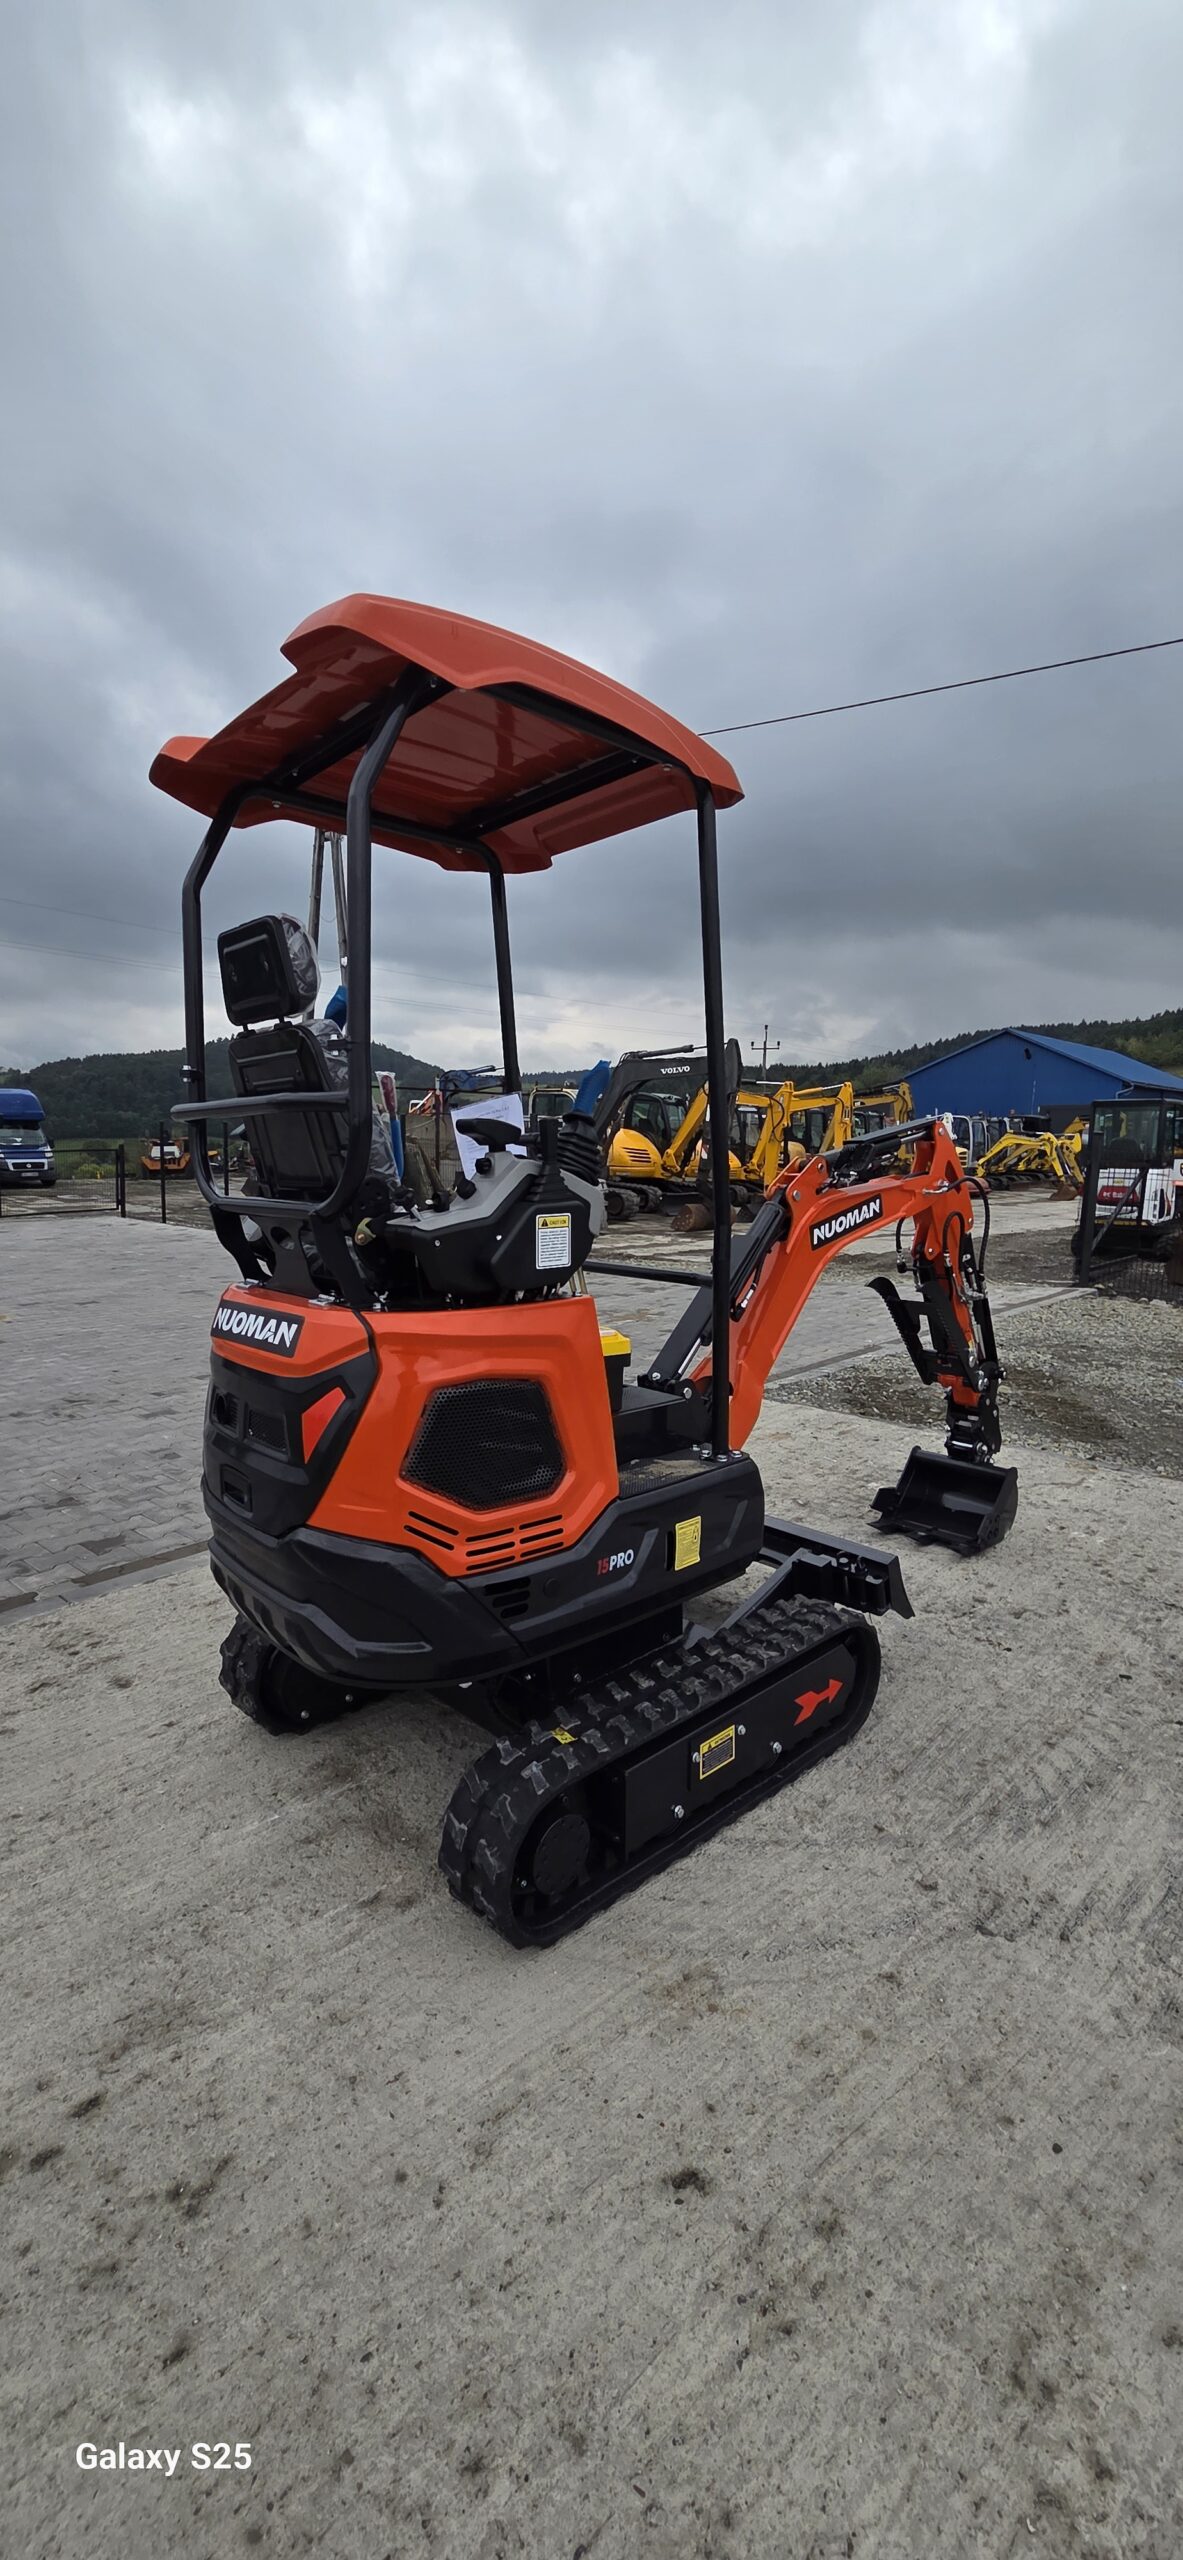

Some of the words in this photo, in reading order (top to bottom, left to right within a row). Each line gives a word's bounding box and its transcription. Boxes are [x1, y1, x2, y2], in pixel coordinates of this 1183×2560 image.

[660, 1065, 691, 1075] VOLVO
[813, 1198, 880, 1246] NUOMAN
[212, 1307, 298, 1348] NUOMAN
